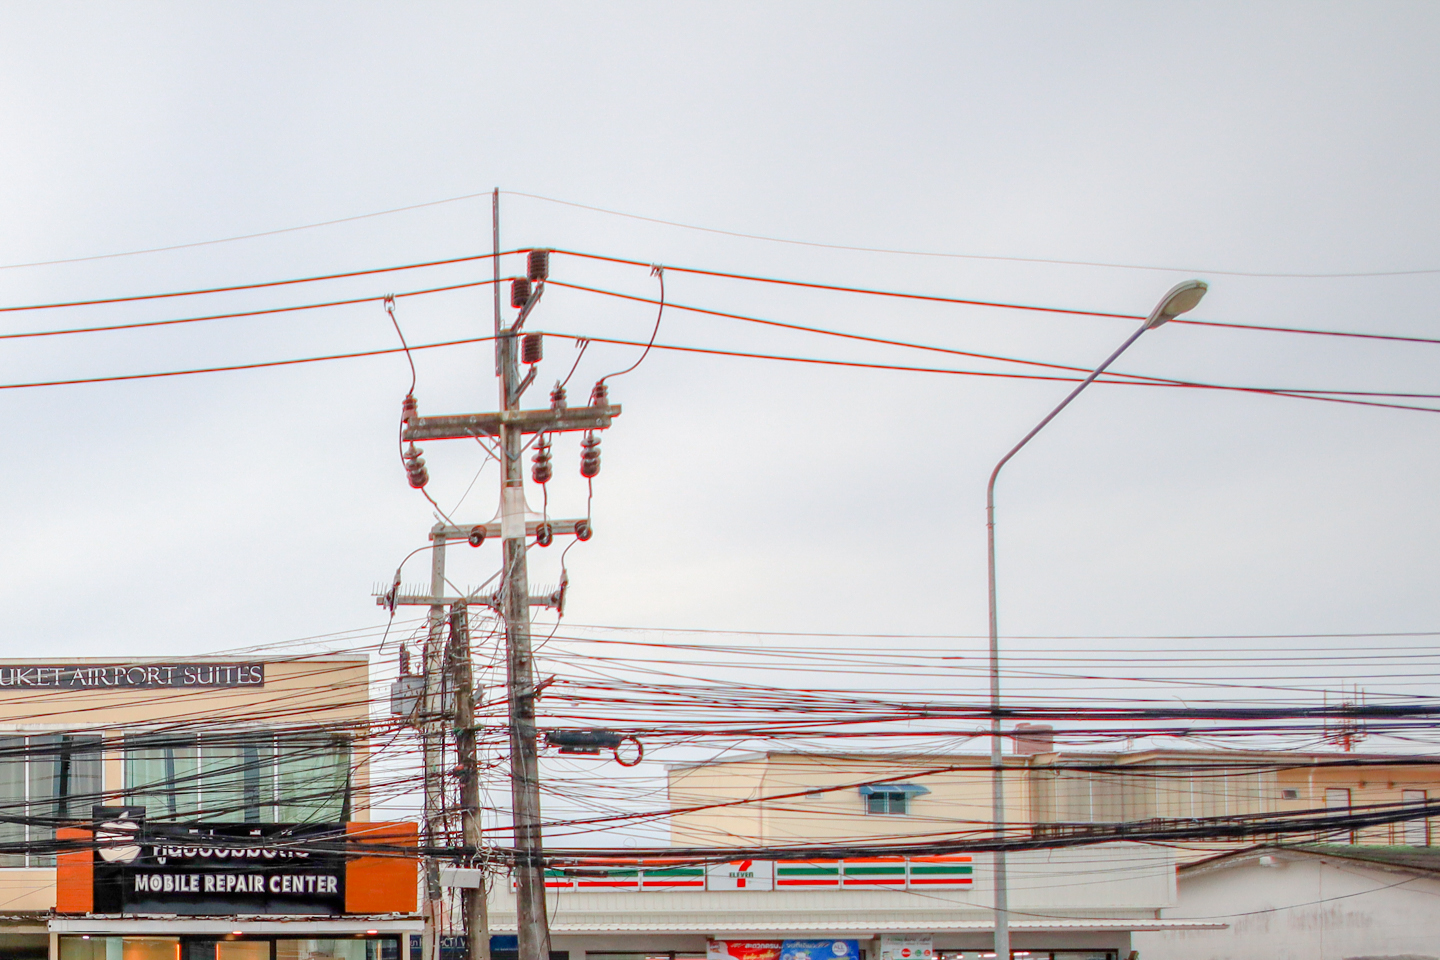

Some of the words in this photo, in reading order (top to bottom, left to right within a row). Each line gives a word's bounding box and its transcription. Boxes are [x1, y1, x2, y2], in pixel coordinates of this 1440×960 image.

[69, 666, 177, 687] AIRPORT
[183, 666, 262, 685] SUITES
[134, 874, 200, 893] MOBILE
[204, 874, 265, 893] REPAIR
[269, 875, 338, 893] CENTER
